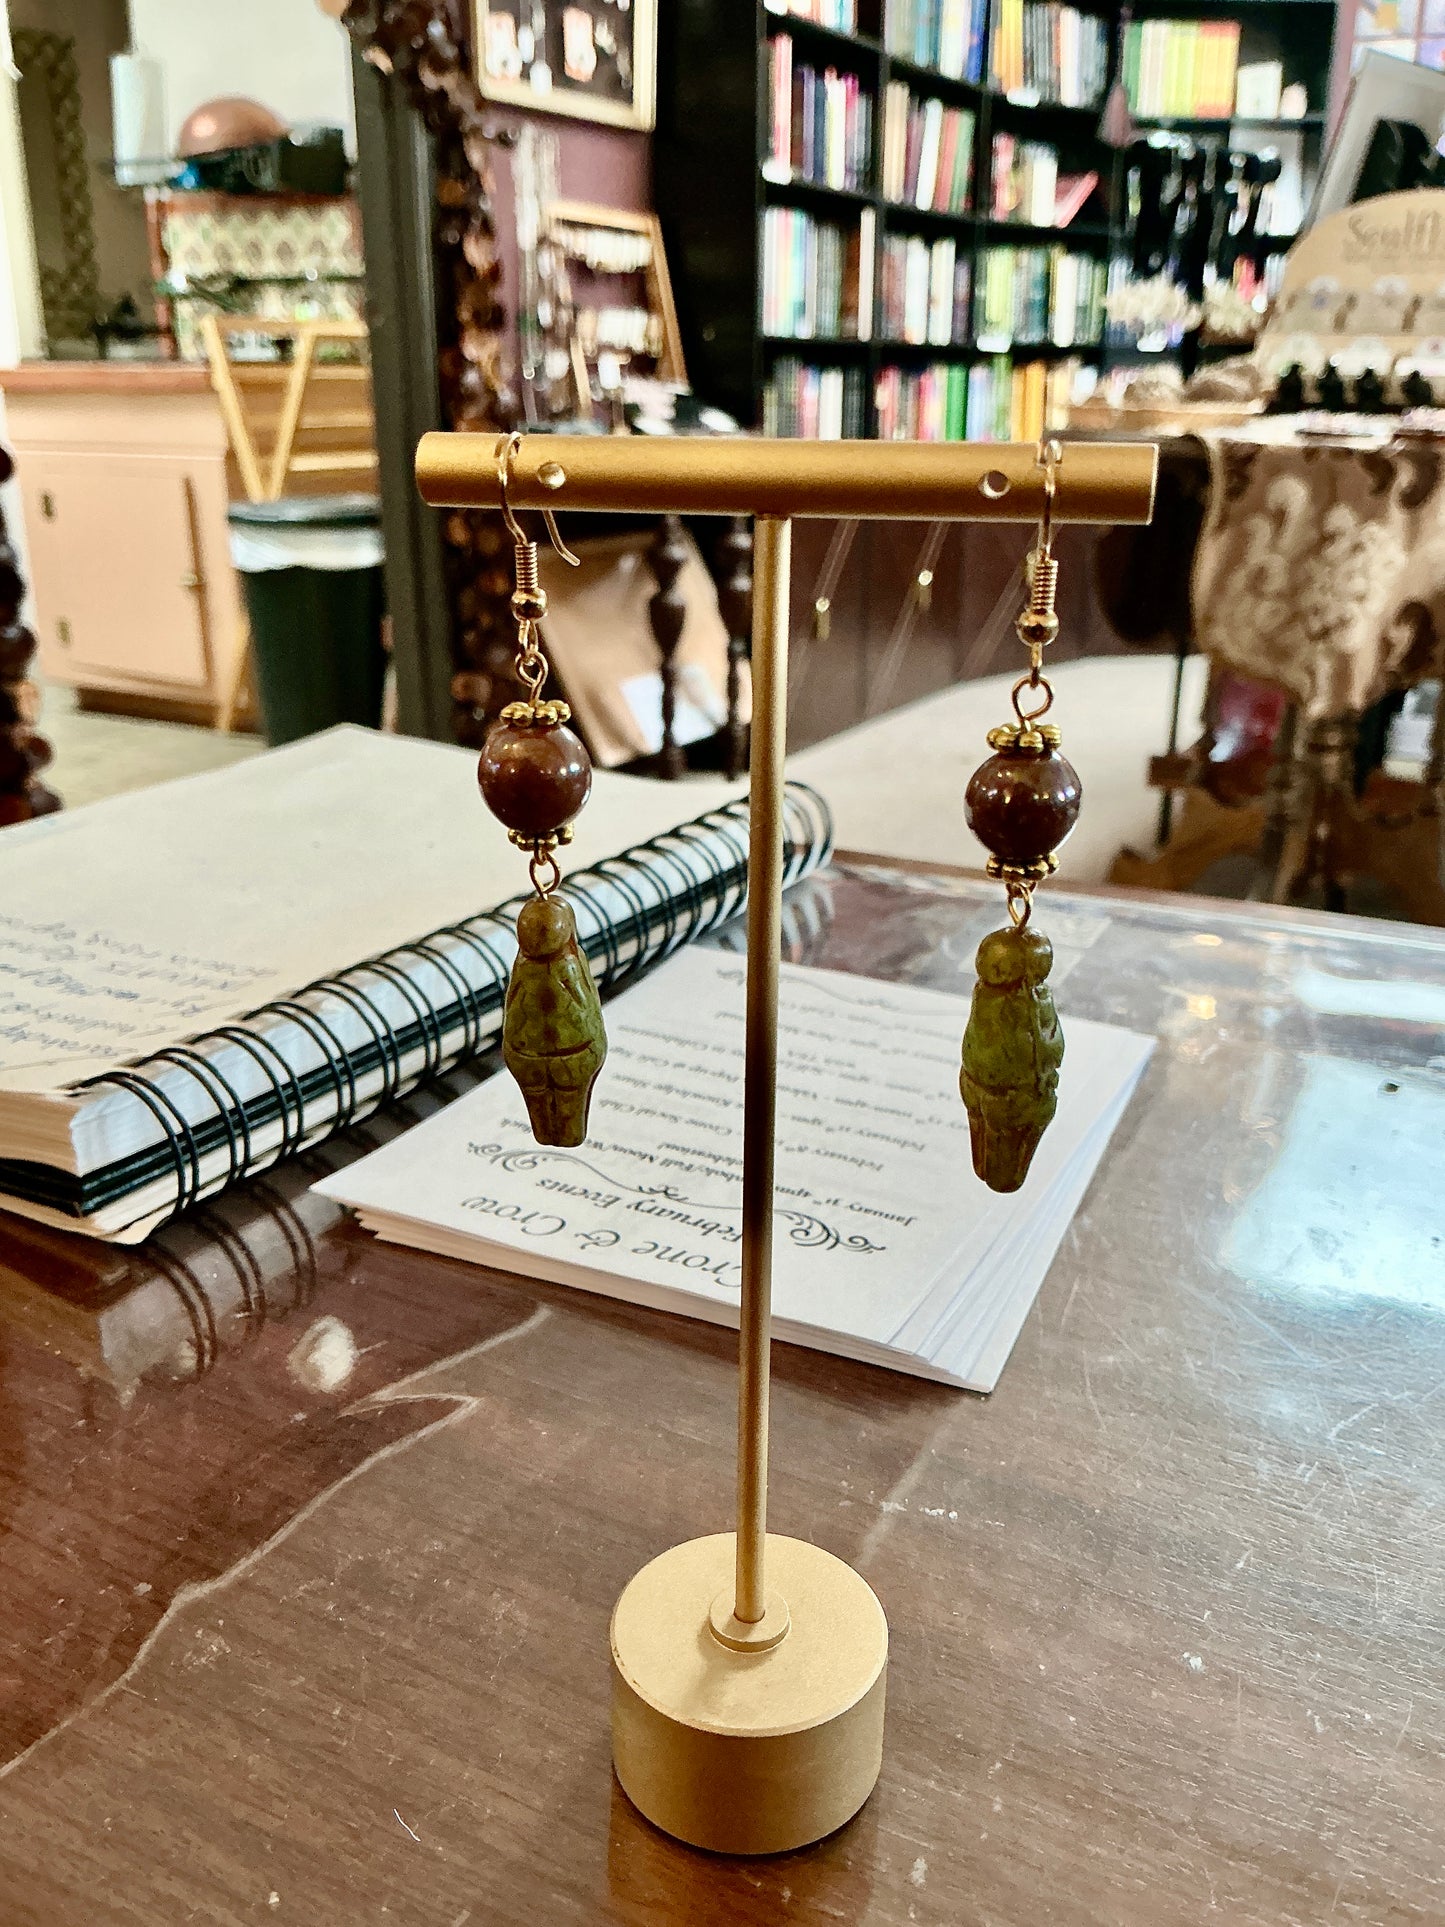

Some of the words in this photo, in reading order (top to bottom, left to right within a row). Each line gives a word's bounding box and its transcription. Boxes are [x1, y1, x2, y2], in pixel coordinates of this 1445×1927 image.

[855, 1130, 926, 1152] February
[656, 1144, 745, 1166] elebration!
[814, 1150, 884, 1172] February
[535, 1180, 622, 1209] Events
[460, 1198, 567, 1236] Crow
[625, 1200, 744, 1243] February
[847, 1204, 916, 1227] January
[573, 1230, 621, 1250] &
[630, 1242, 743, 1290] Crone
